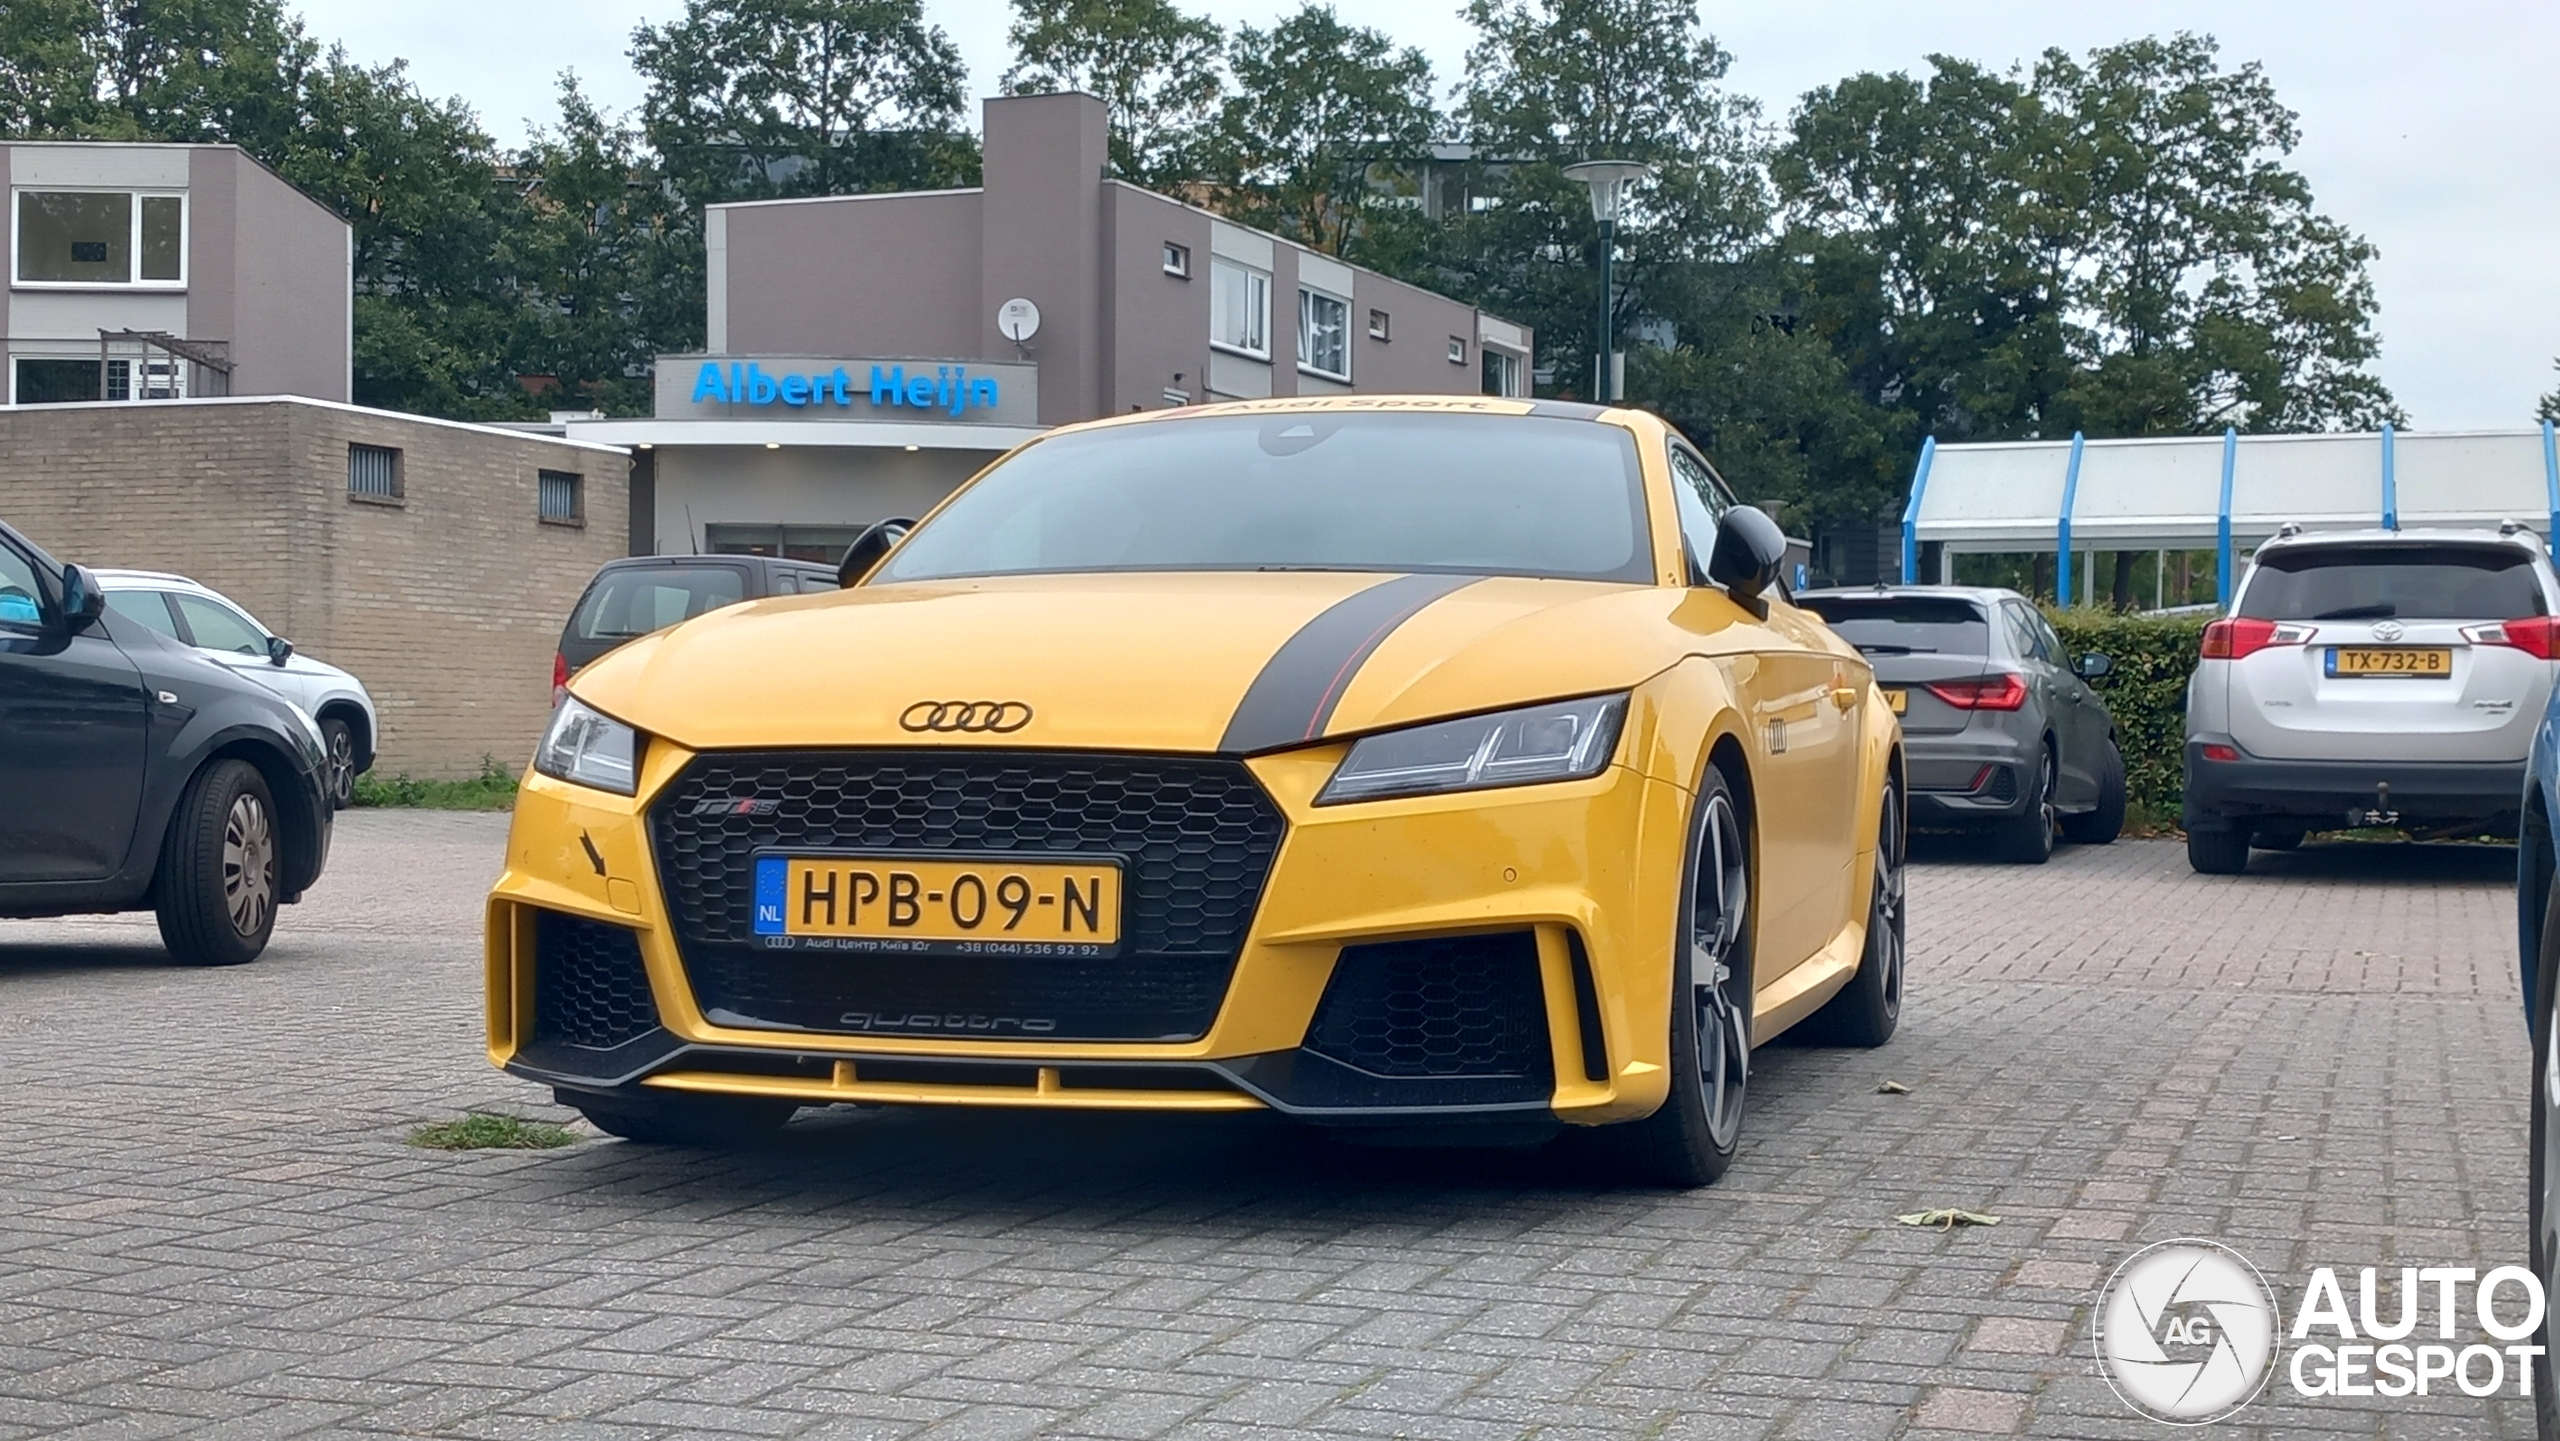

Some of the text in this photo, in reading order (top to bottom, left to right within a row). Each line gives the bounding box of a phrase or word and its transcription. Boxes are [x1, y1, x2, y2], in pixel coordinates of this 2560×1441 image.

[692, 361, 999, 417] Albert Heijn
[1217, 400, 1488, 412] Audi Sport
[2346, 652, 2440, 670] TX-732-B
[802, 869, 1100, 932] HPB-09-N
[759, 905, 782, 922] NL
[805, 938, 834, 948] Audi
[955, 942, 982, 952] +38
[985, 943, 1021, 955] (044)
[1025, 944, 1052, 954] 536
[1057, 945, 1075, 955] 92
[1081, 945, 1100, 955] 92
[839, 1012, 1057, 1030] quattro
